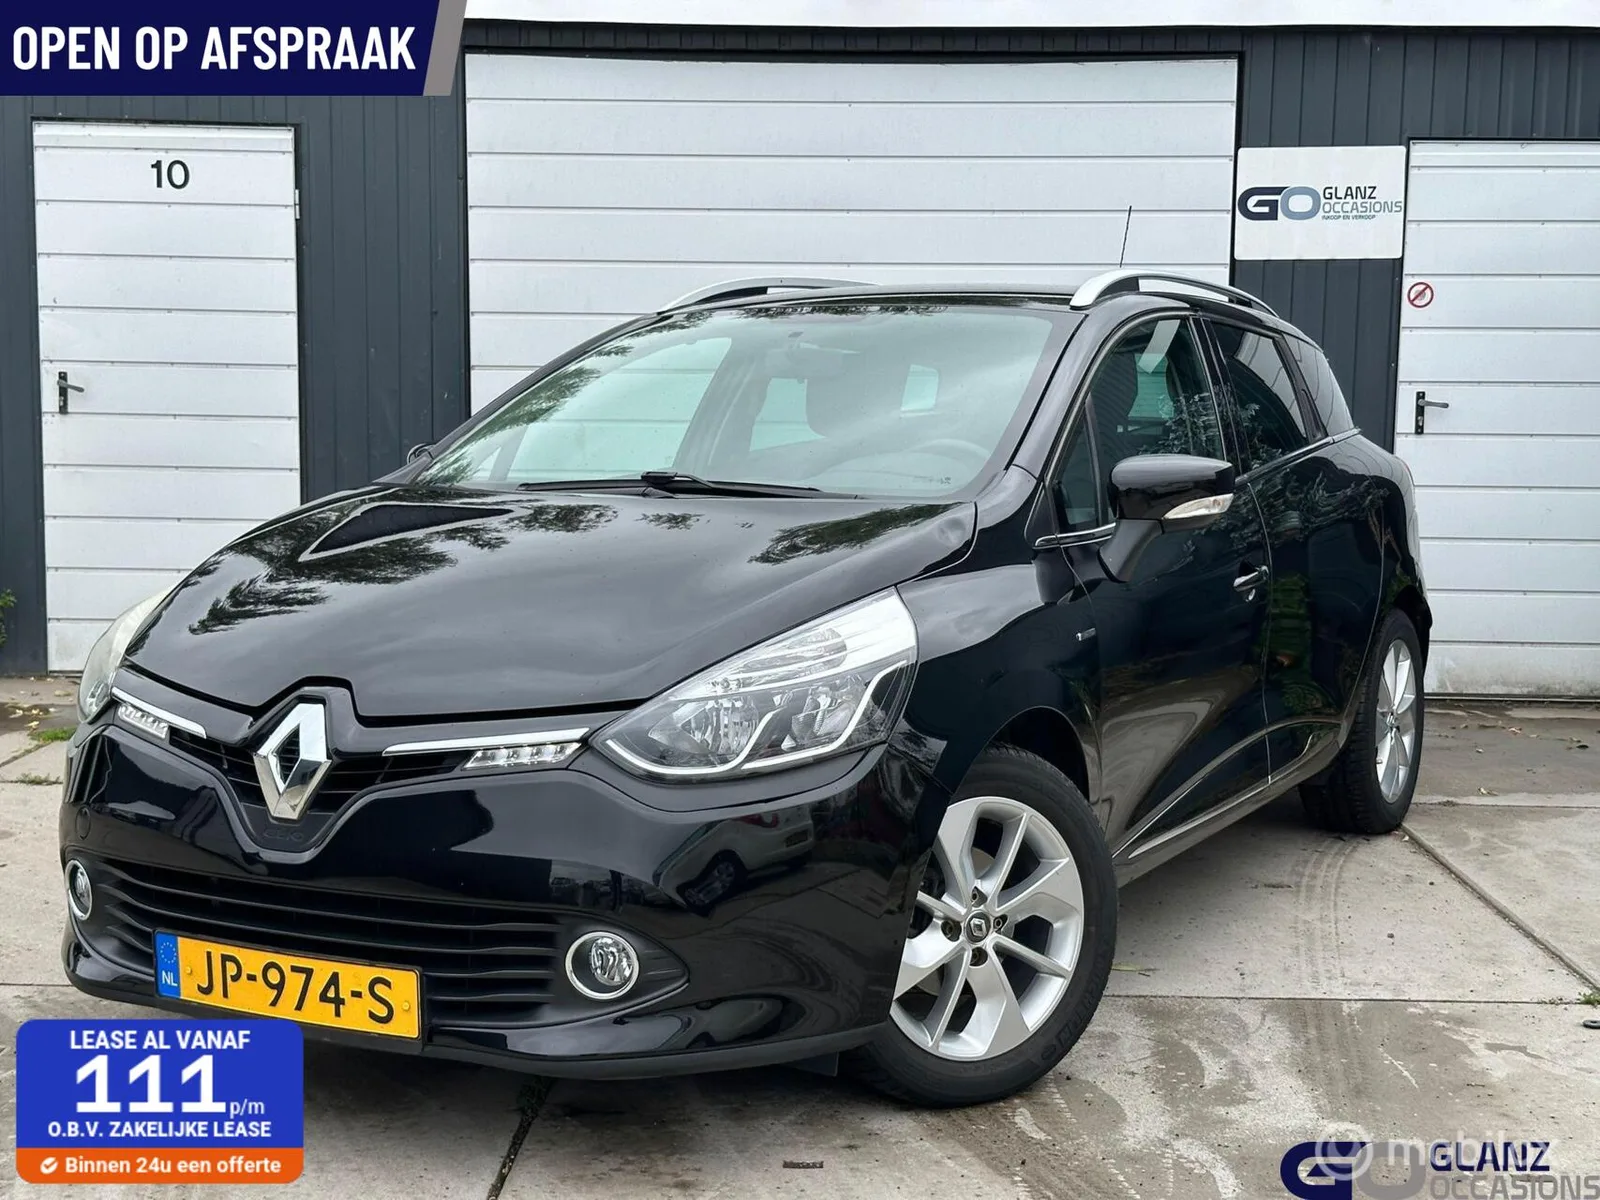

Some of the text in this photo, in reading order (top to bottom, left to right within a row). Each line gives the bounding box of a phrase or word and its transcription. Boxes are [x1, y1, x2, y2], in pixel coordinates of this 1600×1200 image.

[150, 160, 190, 189] 10
[1237, 186, 1321, 221] GO
[1323, 186, 1377, 200] GLANZ
[1322, 201, 1403, 213] OCCASIONS
[161, 970, 178, 987] NL
[197, 950, 394, 1024] JP-974-S
